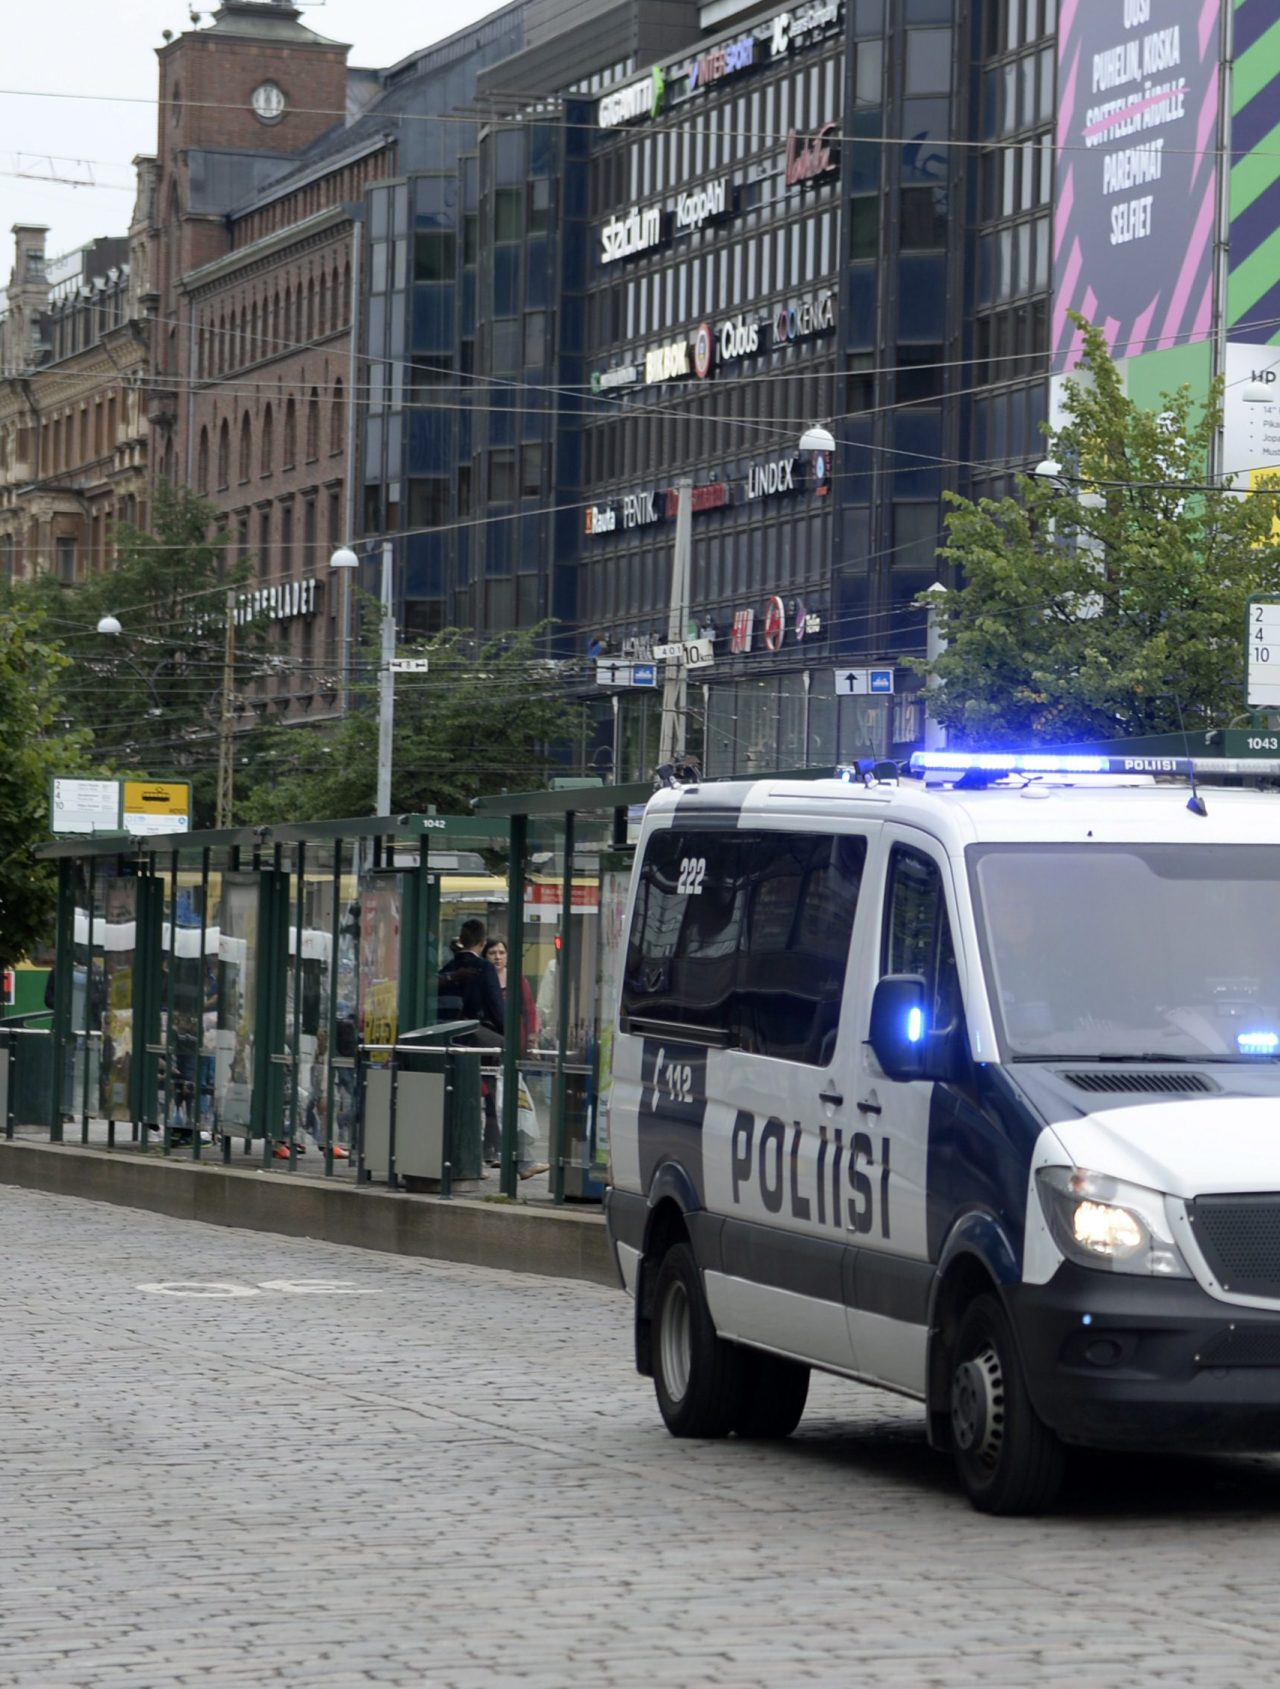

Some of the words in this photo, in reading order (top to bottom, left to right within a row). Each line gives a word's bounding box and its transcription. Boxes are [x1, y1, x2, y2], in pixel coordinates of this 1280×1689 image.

[1143, 25, 1181, 75] KOSKA
[1102, 138, 1164, 195] PAREMMAT
[676, 177, 726, 229] KappAhl
[1110, 196, 1154, 245] SELFIET
[601, 206, 661, 264] stadium
[721, 314, 759, 360] Cubus
[1251, 370, 1276, 386] HP
[748, 457, 794, 499] LINDEX
[1255, 607, 1264, 622] 2
[1255, 627, 1264, 642] 4
[684, 646, 700, 665] 10
[1254, 647, 1270, 662] 10
[1247, 737, 1278, 750] 1043
[1124, 759, 1177, 771] POLIISI
[423, 819, 446, 829] 1042
[677, 857, 706, 895] 222
[665, 1065, 693, 1103] 112
[732, 1110, 891, 1239] POLIISI
